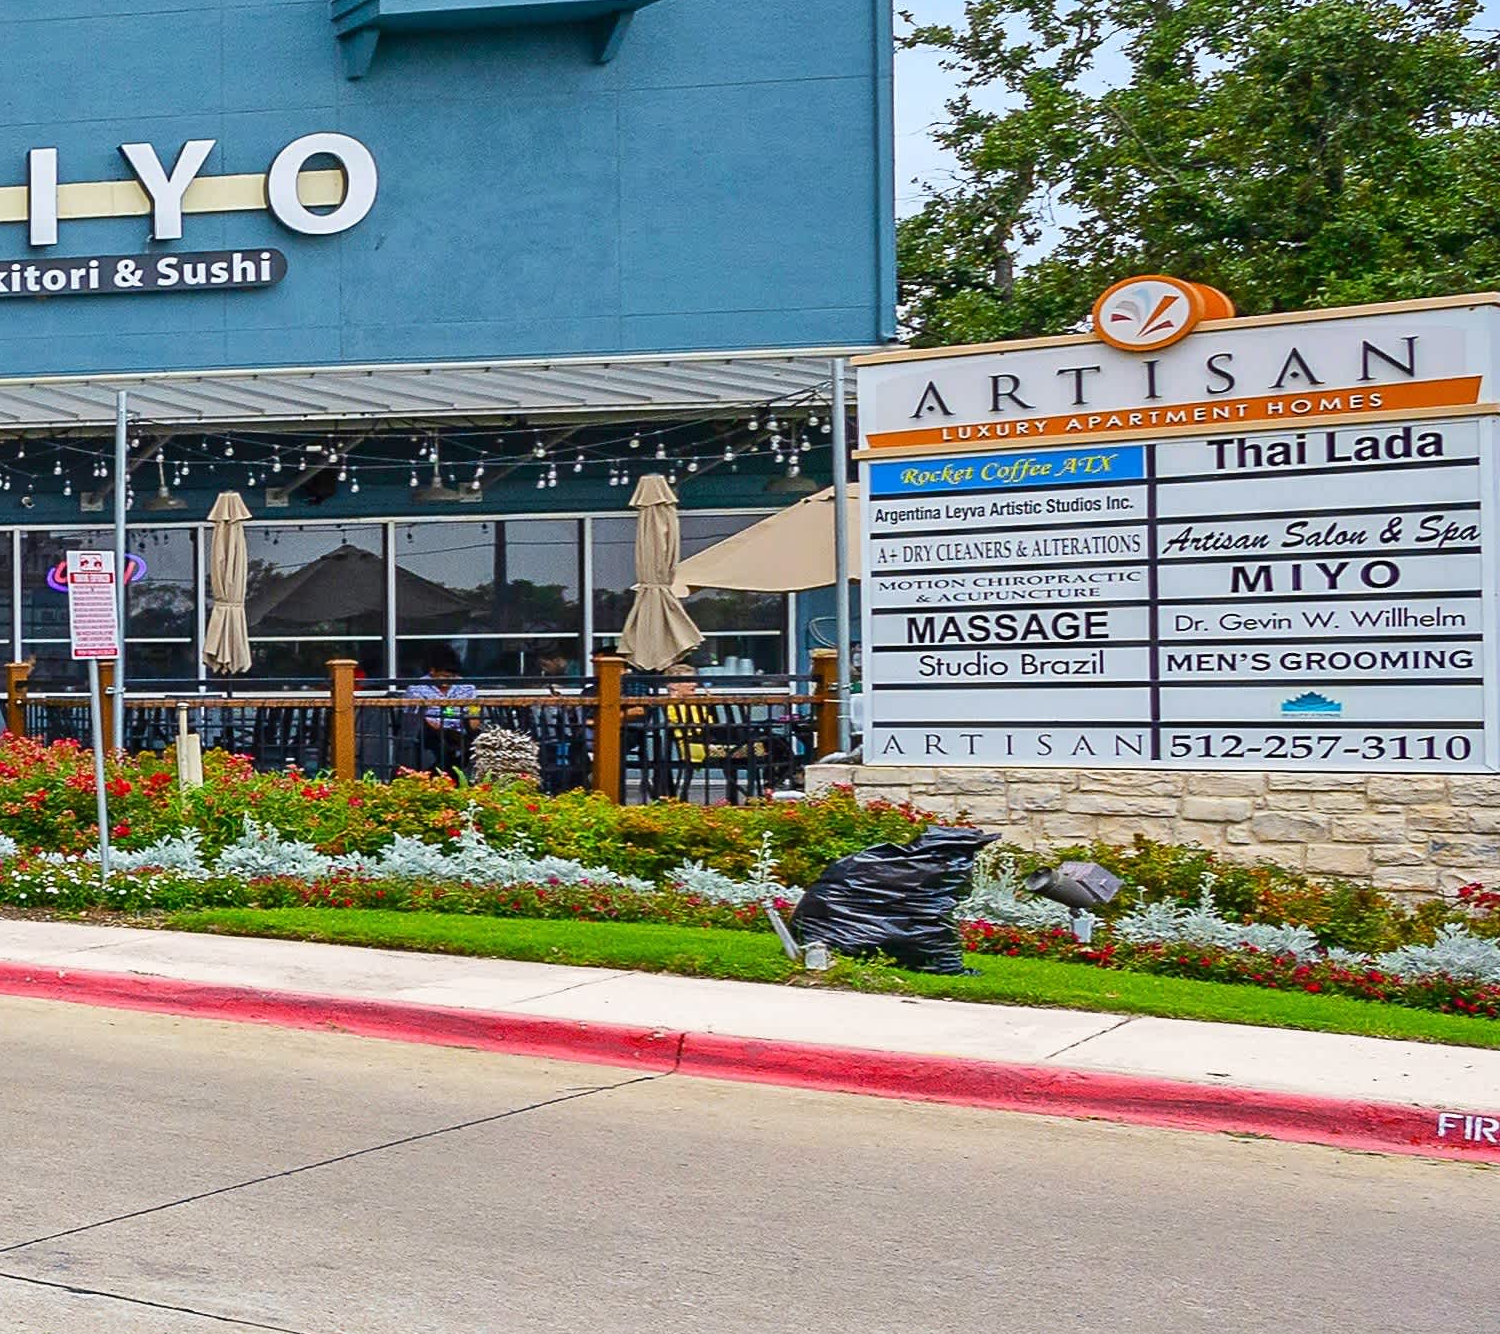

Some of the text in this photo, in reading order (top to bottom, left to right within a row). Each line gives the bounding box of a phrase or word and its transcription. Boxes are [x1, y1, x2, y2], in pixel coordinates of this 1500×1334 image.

[113, 258, 143, 288] &
[157, 251, 272, 285] Sushi
[909, 335, 1421, 419] ARTISAN
[941, 392, 1384, 442] LUXURY APARTMENT HOMES
[1206, 426, 1444, 470] Thai Lada
[900, 454, 1118, 487] Rocket Coffee ATX
[874, 494, 1135, 525] Argentina Leyva Artistic Studios Inc.
[877, 534, 1141, 564] A+ DRY CLEANERS & ALTERATIONS
[1162, 514, 1481, 555] Artisan Salon & Spa
[879, 570, 1142, 592] MOTION CHIROPRACTIC
[1231, 559, 1401, 594] MIYO
[915, 587, 1101, 604] & ACUPUNCTURE
[906, 610, 1109, 644] MASSAGE
[1174, 606, 1466, 632] Dr. Gevin W. Willhelm
[918, 649, 1105, 677] Studio Brazil
[1166, 649, 1474, 672] MEN'S GROOMING
[881, 733, 1145, 756] ARTISAN
[1170, 734, 1472, 761] 512-257-3110
[1437, 1112, 1500, 1143] FIR
